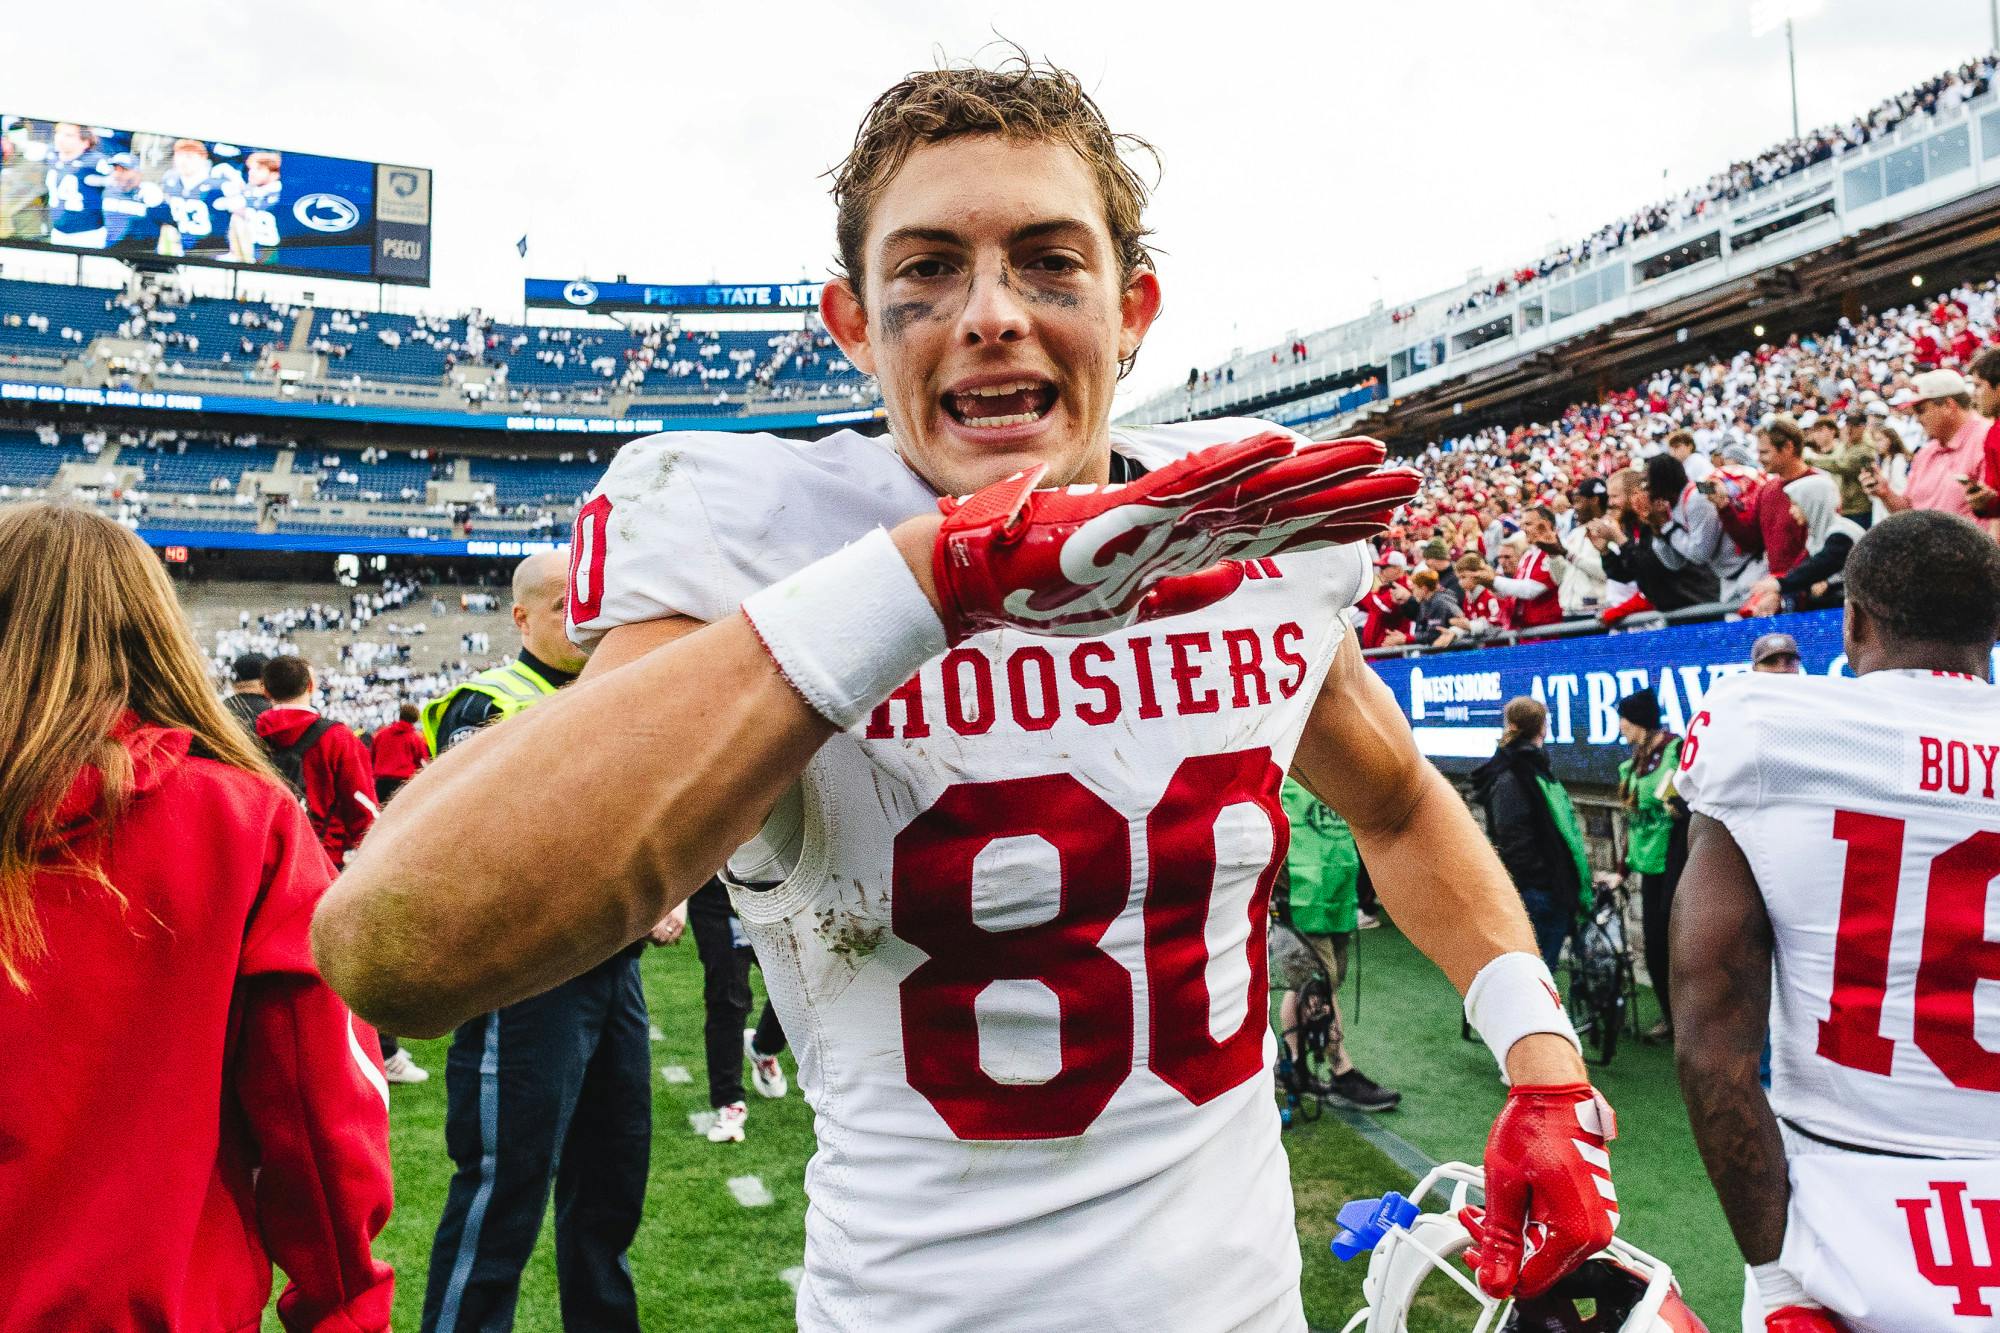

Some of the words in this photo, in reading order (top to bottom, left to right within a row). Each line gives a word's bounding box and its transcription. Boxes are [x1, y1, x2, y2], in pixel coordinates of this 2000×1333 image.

[706, 287, 772, 305] STATE
[866, 621, 1308, 740] HOOSIERS
[1423, 675, 1454, 703] WEST
[1454, 672, 1502, 702] SHORE
[1529, 674, 1578, 744] AT
[1919, 736, 2000, 799] BOY
[892, 746, 1290, 1140] 80
[1816, 809, 2000, 1093] 16
